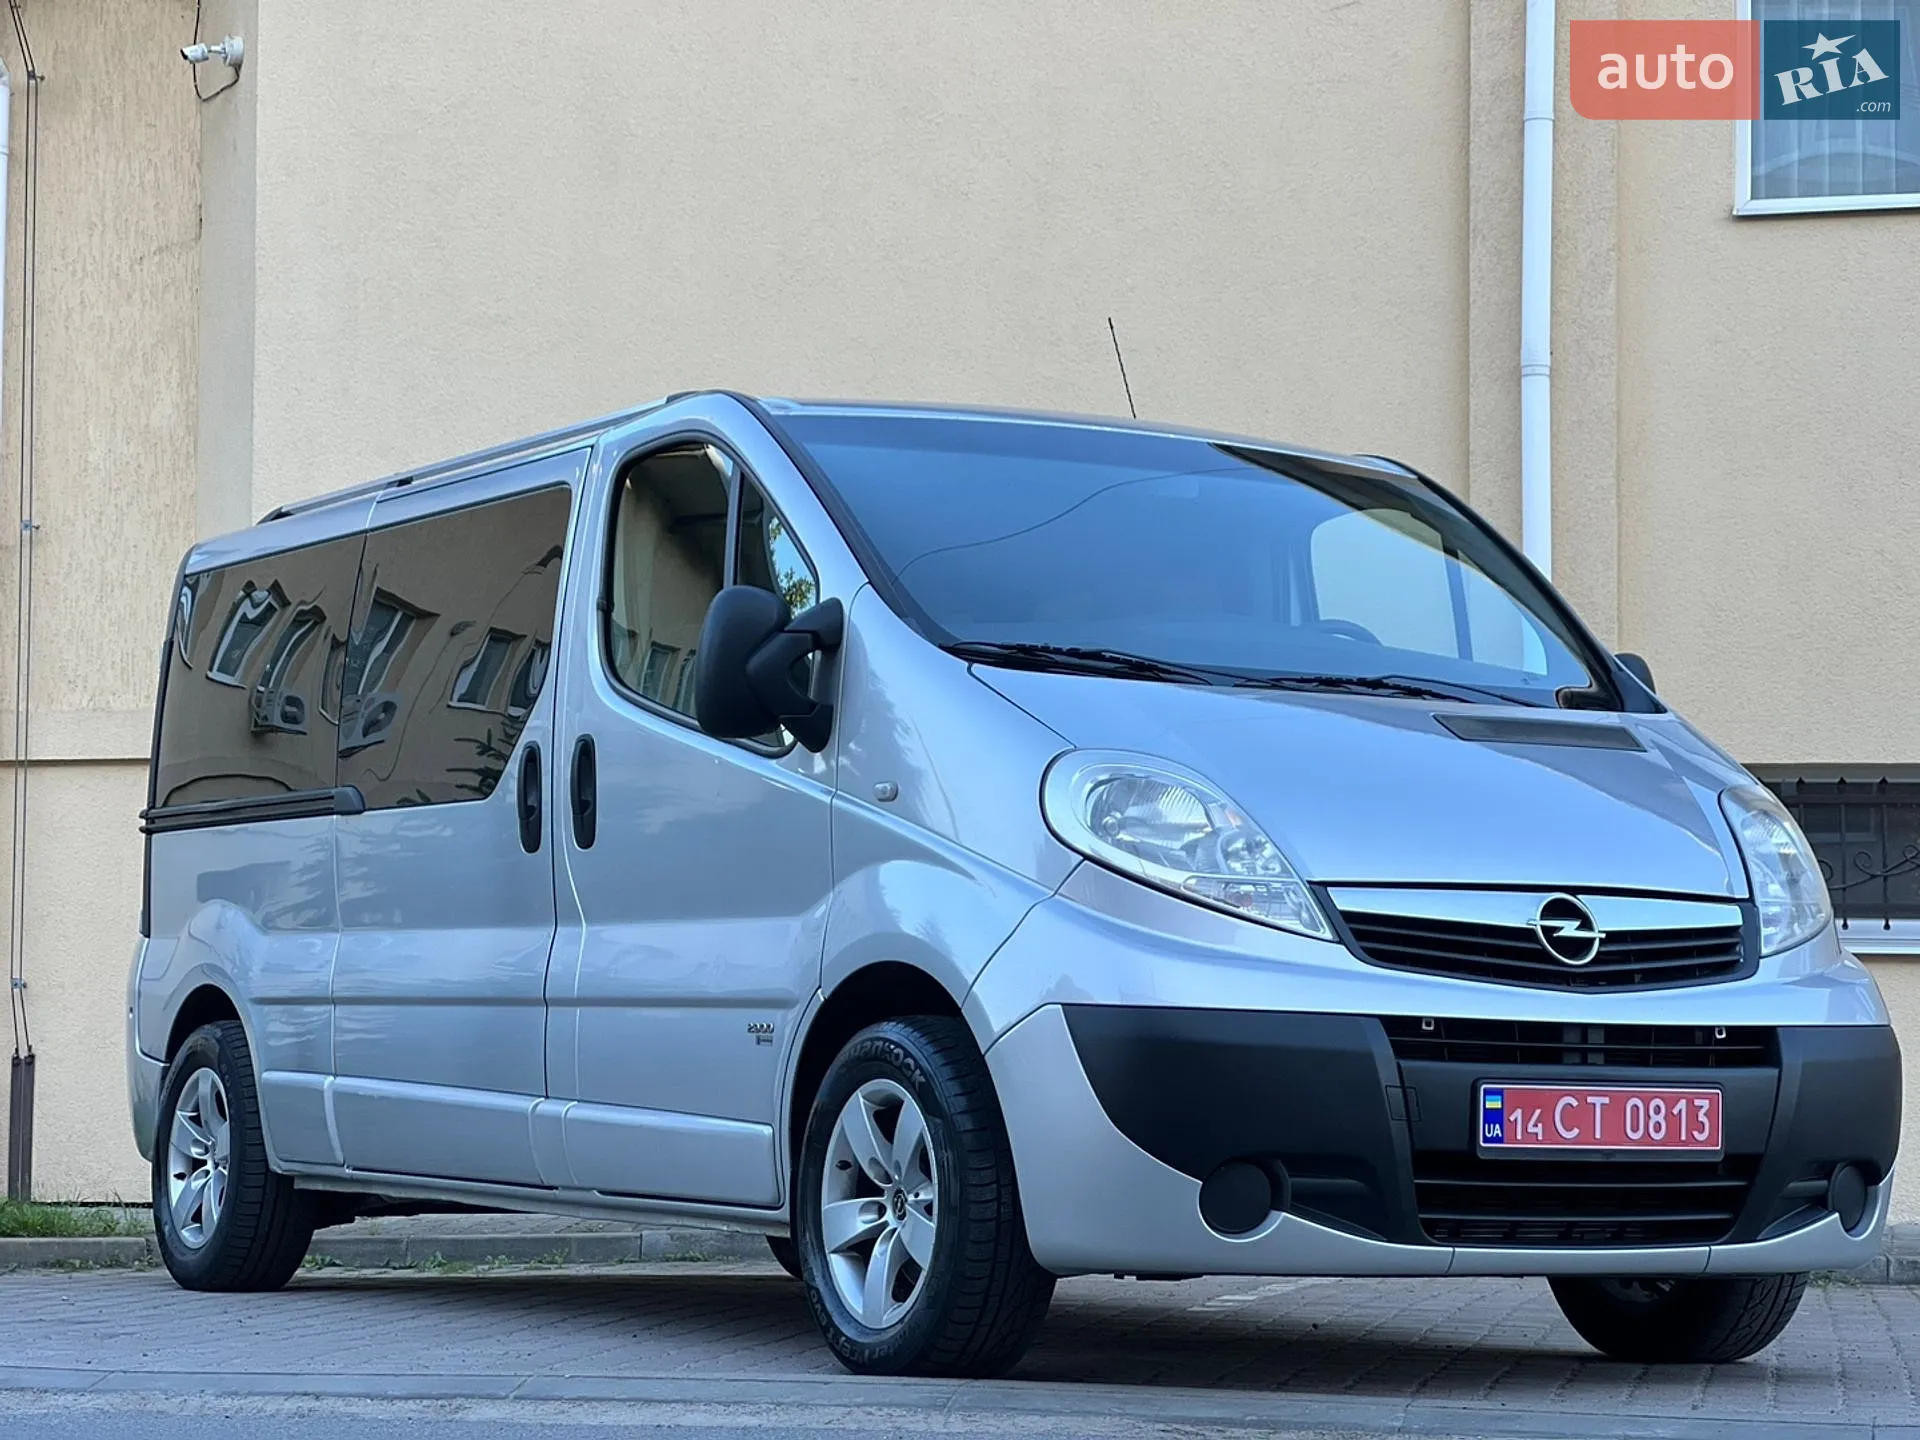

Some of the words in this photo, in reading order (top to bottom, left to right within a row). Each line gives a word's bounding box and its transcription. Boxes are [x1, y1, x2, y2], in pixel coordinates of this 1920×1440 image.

[1485, 1124, 1502, 1138] UA
[1508, 1108, 1543, 1141] 14
[1554, 1095, 1610, 1138] CT
[1625, 1097, 1711, 1141] 0813
